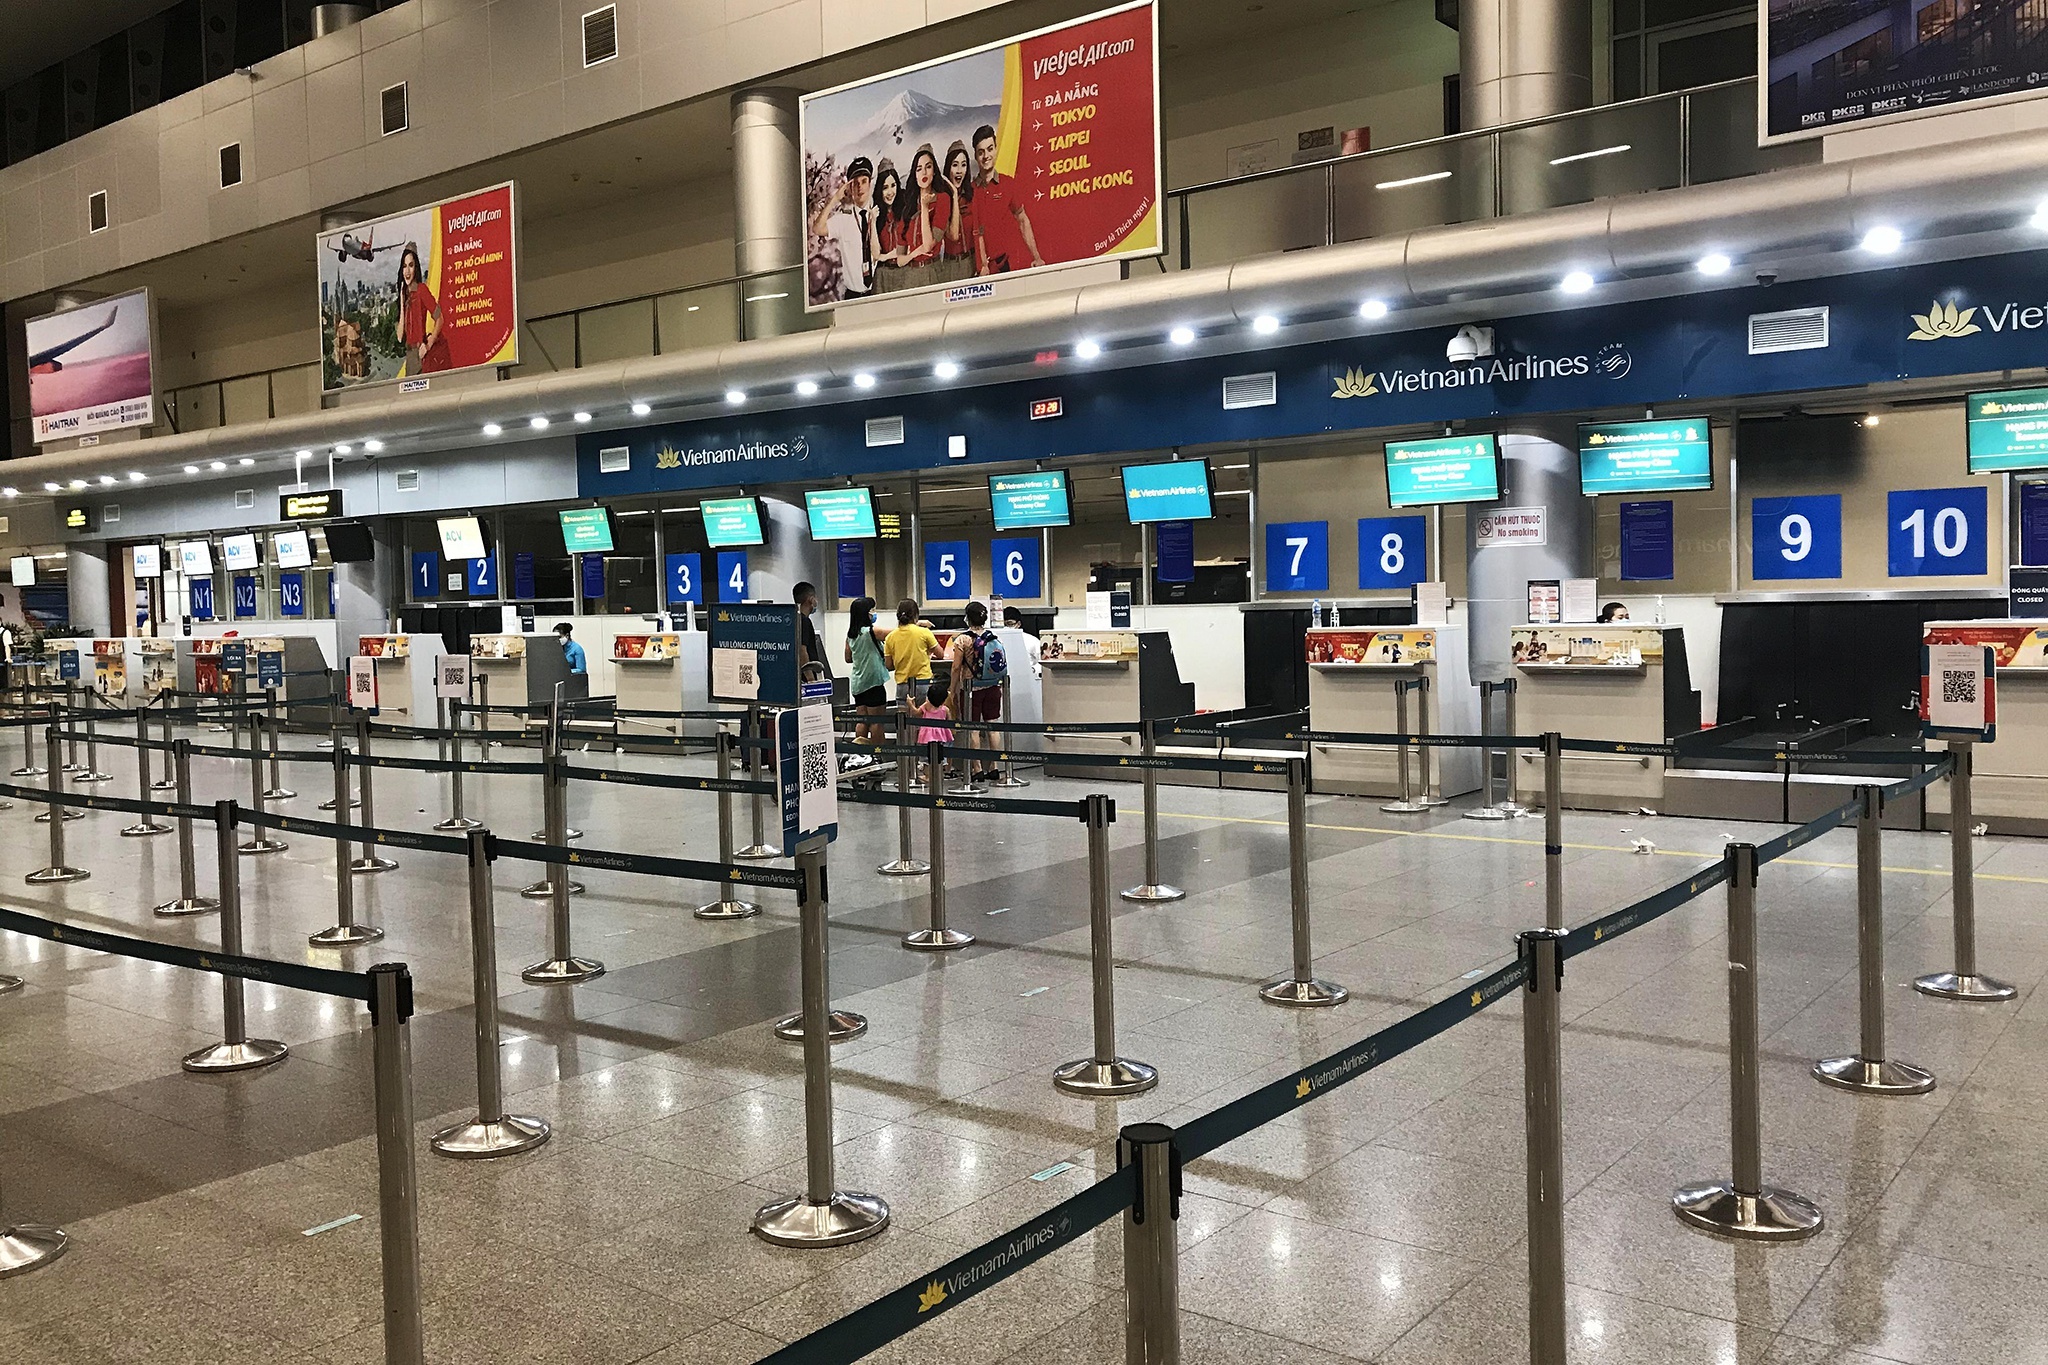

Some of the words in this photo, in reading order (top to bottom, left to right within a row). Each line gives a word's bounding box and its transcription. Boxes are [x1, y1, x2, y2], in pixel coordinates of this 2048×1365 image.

[1044, 90, 1062, 108] ĐÀ
[1871, 96, 1907, 110] DKRT
[1973, 76, 2021, 90] LANDCORP
[1050, 103, 1097, 127] TOKYO
[1048, 129, 1091, 152] TAIPEI
[1048, 154, 1092, 176] SEOUL
[1049, 178, 1091, 200] HONG
[1091, 169, 1134, 191] KONG
[455, 316, 471, 328] NHA
[471, 311, 495, 325] TRANG
[1379, 363, 1485, 394] Vietnam
[1486, 353, 1590, 384] Airlines
[680, 448, 736, 467] Vietnam
[736, 441, 789, 461] Airlines
[1140, 488, 1171, 498] Vietnam
[1170, 486, 1197, 495] Airlines
[445, 530, 462, 542] ACV
[1497, 528, 1507, 537] No
[1508, 528, 1539, 538] smoking
[1779, 513, 1813, 562] 9
[1900, 507, 1969, 558] 10
[136, 554, 147, 564] ACV
[184, 551, 196, 562] ACV
[228, 545, 241, 557] ACV
[280, 543, 293, 554] ACV
[1285, 536, 1309, 576] 7
[1380, 532, 1405, 574] 8
[420, 562, 428, 588] 1
[476, 558, 488, 586] 2
[677, 564, 691, 594] 3
[729, 562, 744, 593] 4
[939, 554, 956, 588] 5
[1006, 550, 1024, 586] 6
[194, 587, 210, 609] N1
[236, 585, 254, 607] N2
[282, 583, 300, 606] N3
[730, 613, 758, 623] Vietnam
[757, 613, 783, 624] Airlines
[719, 640, 730, 648] VUI
[730, 640, 746, 649] LÒNG
[777, 641, 790, 651] NÀY
[968, 800, 989, 809] Airlines
[580, 855, 605, 864] Vietnam
[604, 856, 626, 867] Airlines
[742, 871, 770, 882] Vietnam
[769, 873, 796, 884] Airlines
[1481, 980, 1503, 1000] Vietnam
[1502, 969, 1522, 990] Airlines
[1309, 1065, 1343, 1092] Vietnam
[1342, 1051, 1369, 1073] Airlines
[946, 1250, 1007, 1295] Vietnam
[1006, 1223, 1055, 1263] Airlines
